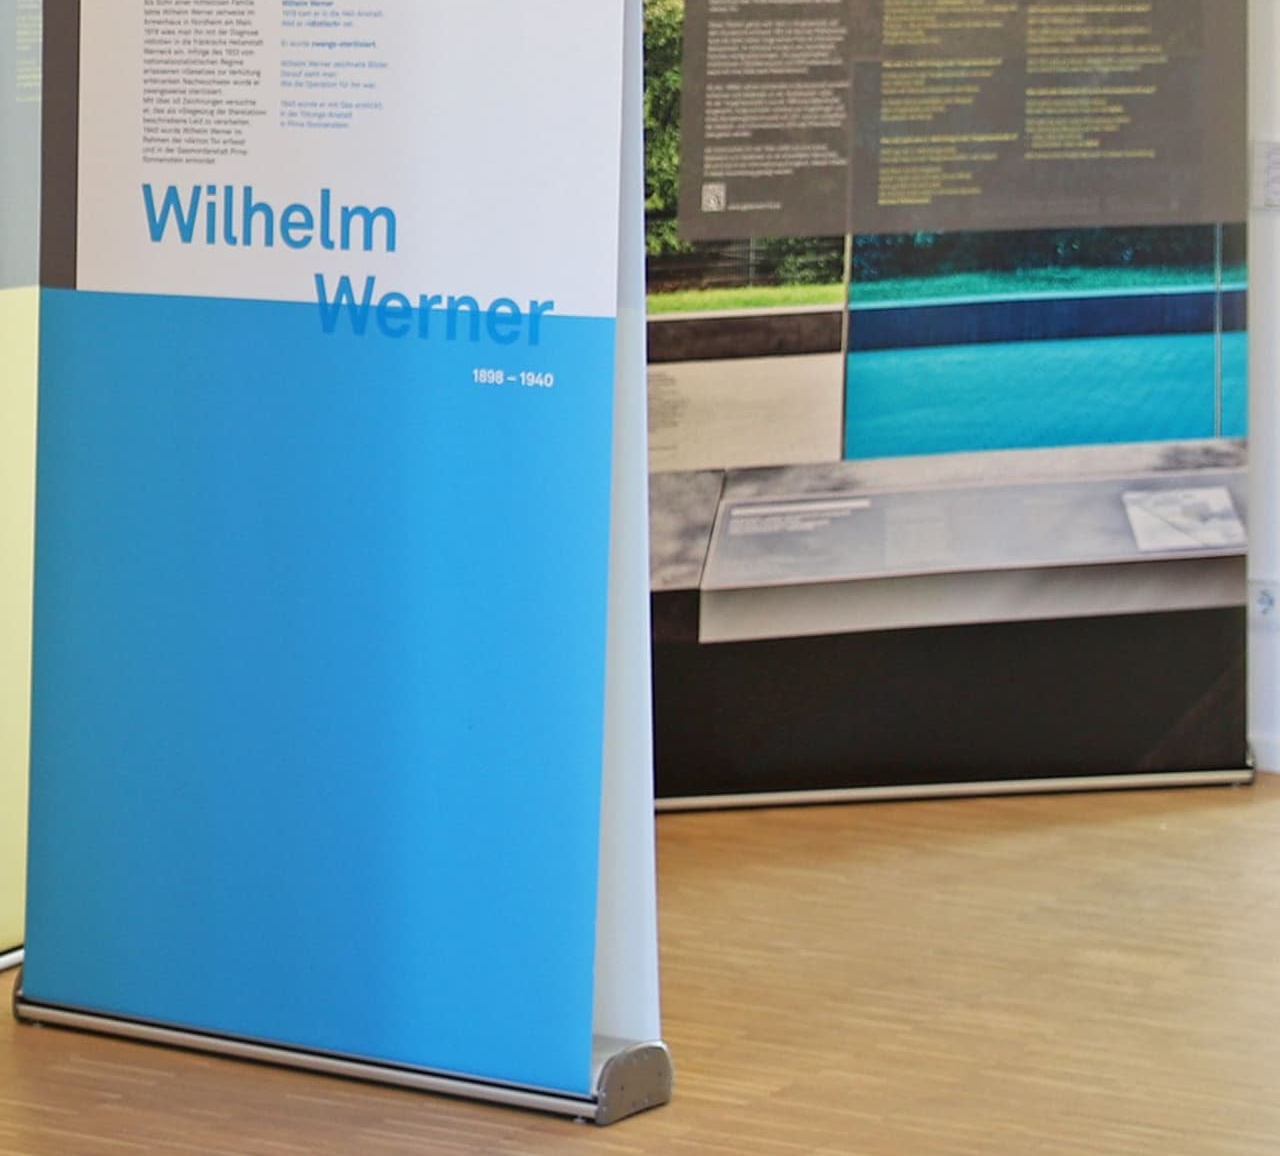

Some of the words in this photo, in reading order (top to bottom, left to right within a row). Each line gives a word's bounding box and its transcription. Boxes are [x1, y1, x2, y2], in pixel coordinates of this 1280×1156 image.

[142, 183, 397, 253] Wilhelm
[314, 273, 554, 346] Werner
[471, 368, 504, 386] 1898
[519, 371, 555, 389] 1940
